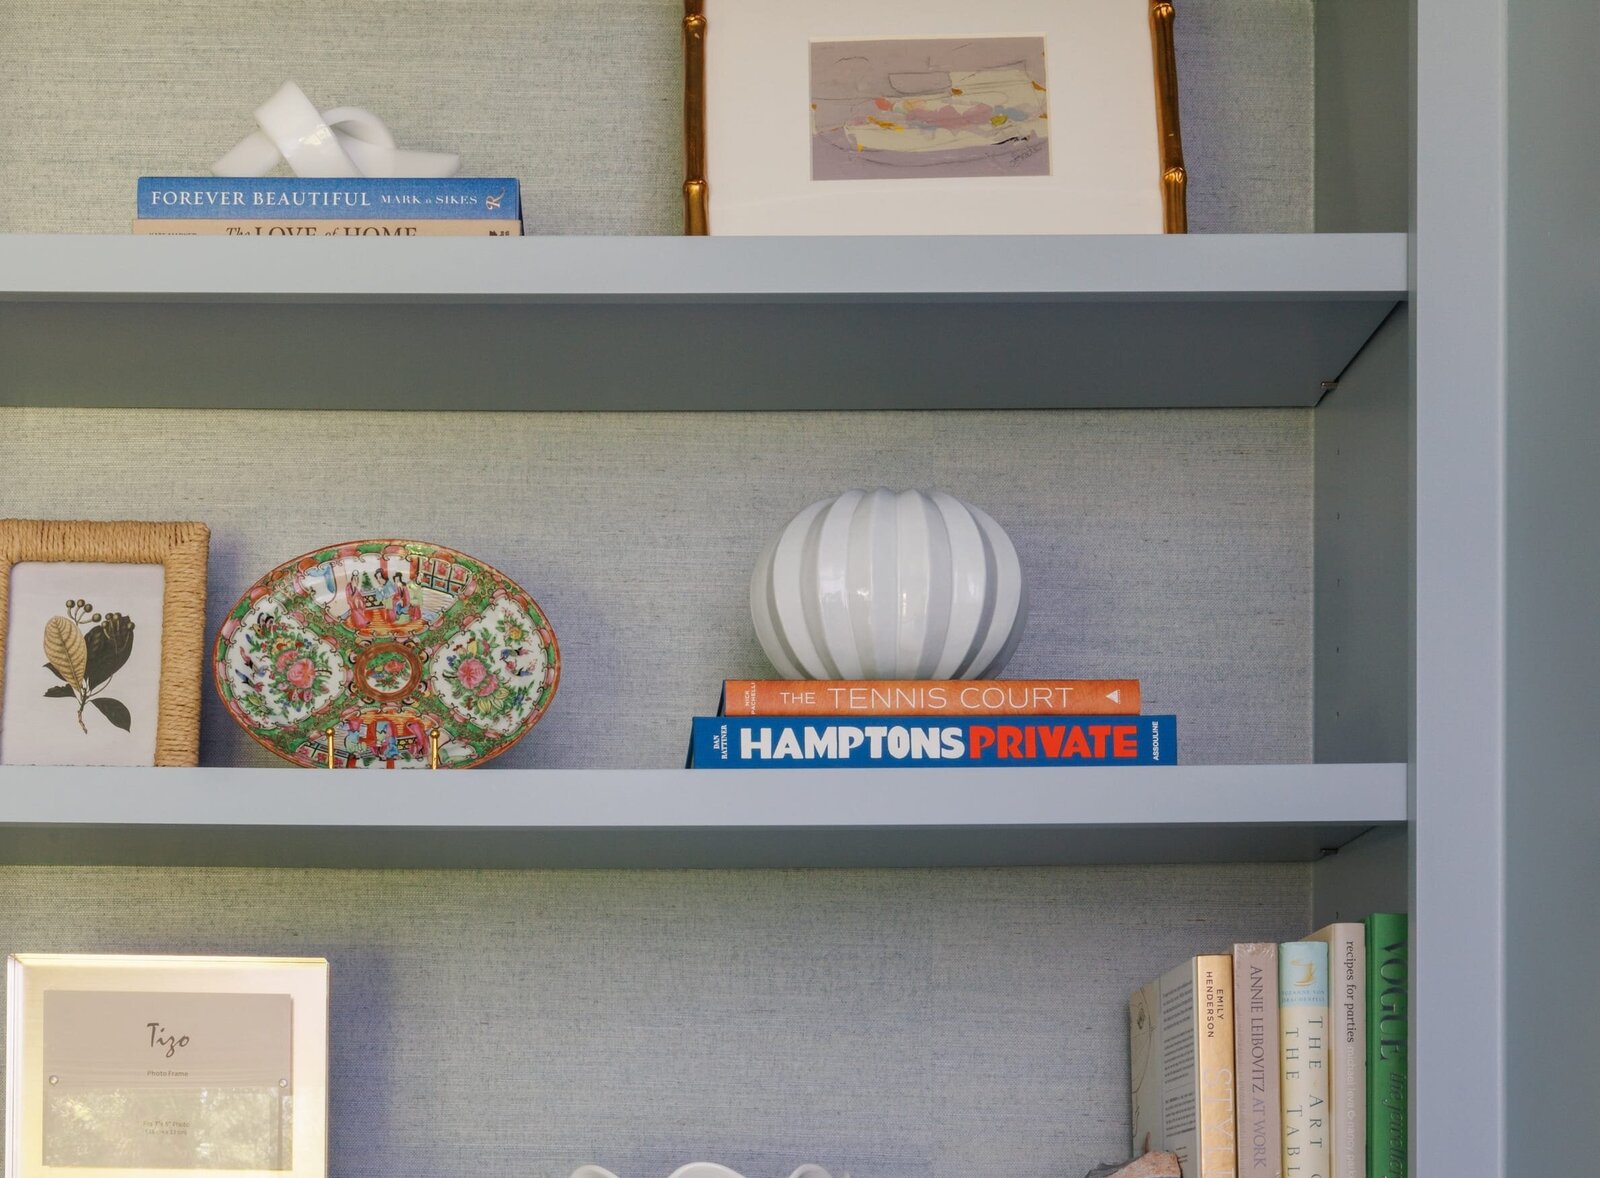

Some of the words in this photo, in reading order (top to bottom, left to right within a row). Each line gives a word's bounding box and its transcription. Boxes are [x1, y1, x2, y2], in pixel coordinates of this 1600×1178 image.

[151, 191, 246, 206] FOREVER
[253, 191, 371, 206] BEAUTIFUL
[380, 194, 421, 204] MARK
[435, 194, 478, 205] SIKES
[779, 692, 816, 705] THE
[827, 687, 947, 709] TENNIS
[960, 687, 1074, 709] COURT
[740, 725, 965, 760] HAMPTONS
[969, 724, 1138, 759] PRIVATE
[1344, 940, 1357, 981] recipes
[1205, 971, 1215, 1038] HENDERSON
[1216, 988, 1224, 1020] EMILY
[1250, 965, 1264, 1013] ANNIE
[1347, 984, 1357, 1000] for
[1380, 940, 1408, 1061] VOGUE
[147, 1022, 190, 1058] Tizo
[1308, 1016, 1323, 1069] THE
[1344, 1003, 1357, 1043] parties
[1251, 1017, 1265, 1093] LEIBOVITZ
[1285, 1027, 1299, 1080] THE
[1252, 1096, 1266, 1116] AT
[1309, 1094, 1324, 1148] ART
[1253, 1118, 1267, 1169] WORK
